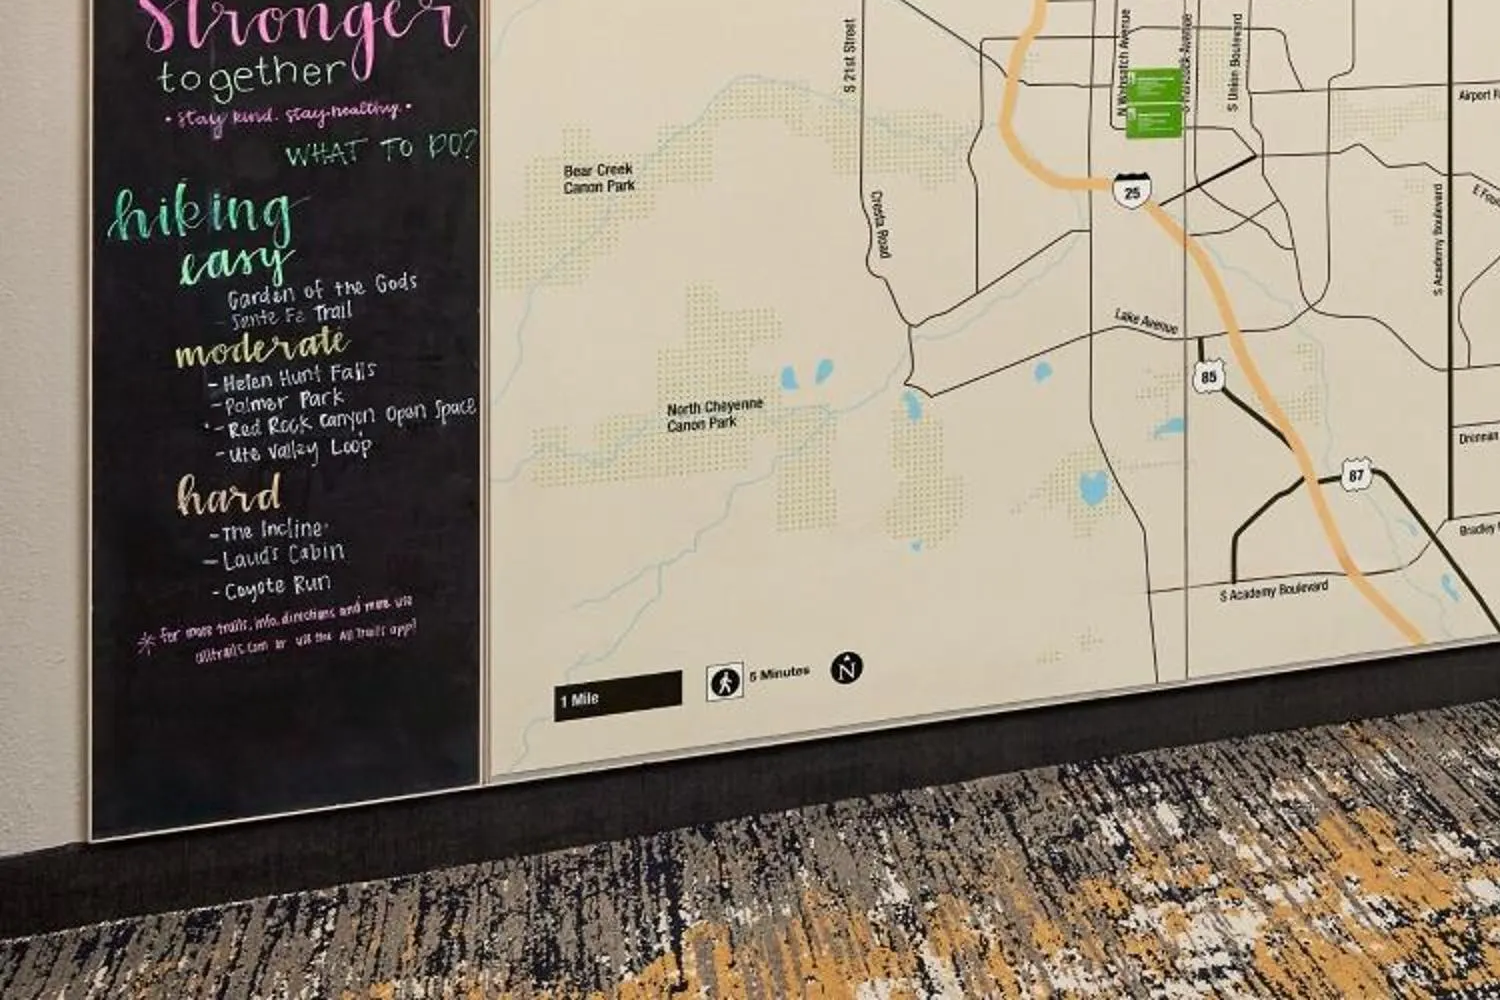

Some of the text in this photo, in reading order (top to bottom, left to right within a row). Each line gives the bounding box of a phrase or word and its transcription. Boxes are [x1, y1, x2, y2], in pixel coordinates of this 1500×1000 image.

[844, 18, 857, 93] S 21st Street
[1227, 13, 1243, 112] S Union Boulevard
[157, 55, 347, 104] together
[1459, 89, 1491, 102] Airport
[286, 129, 478, 166] WHAT TO DO?
[564, 163, 633, 178] Bear Creek
[563, 179, 635, 195] Canon Park
[1125, 187, 1141, 200] 25
[107, 178, 311, 249] hiking
[1433, 183, 1442, 236] Boulevard
[871, 191, 890, 259] Cresta Road
[180, 247, 297, 289] easy
[1433, 238, 1444, 287] Academy
[228, 272, 418, 311] Garden of the Gods
[314, 301, 352, 322] Trail
[1114, 307, 1179, 335] Lake Avenue
[176, 325, 351, 369] moderate
[223, 361, 377, 392] Helen Hunt Falls
[1201, 371, 1217, 384] 85
[225, 389, 344, 416] Palmer Park
[667, 397, 764, 417] North Cheyenne
[228, 421, 262, 439] Red
[268, 416, 313, 436] Rock
[385, 404, 427, 424] Open
[435, 398, 477, 426] Space
[667, 415, 737, 433] Canon Park
[331, 436, 373, 459] Loop
[1459, 431, 1499, 445] Drennan
[1349, 469, 1364, 482] 87
[177, 472, 281, 517] hard
[222, 519, 323, 542] The Incline
[1460, 522, 1495, 536] Bradley
[289, 542, 345, 565] Cabin
[225, 574, 331, 603] Coyote Run
[1220, 579, 1329, 604] S Academy Boulevard
[750, 665, 810, 682] 5 Minutes
[561, 692, 599, 708] 1 Mile
